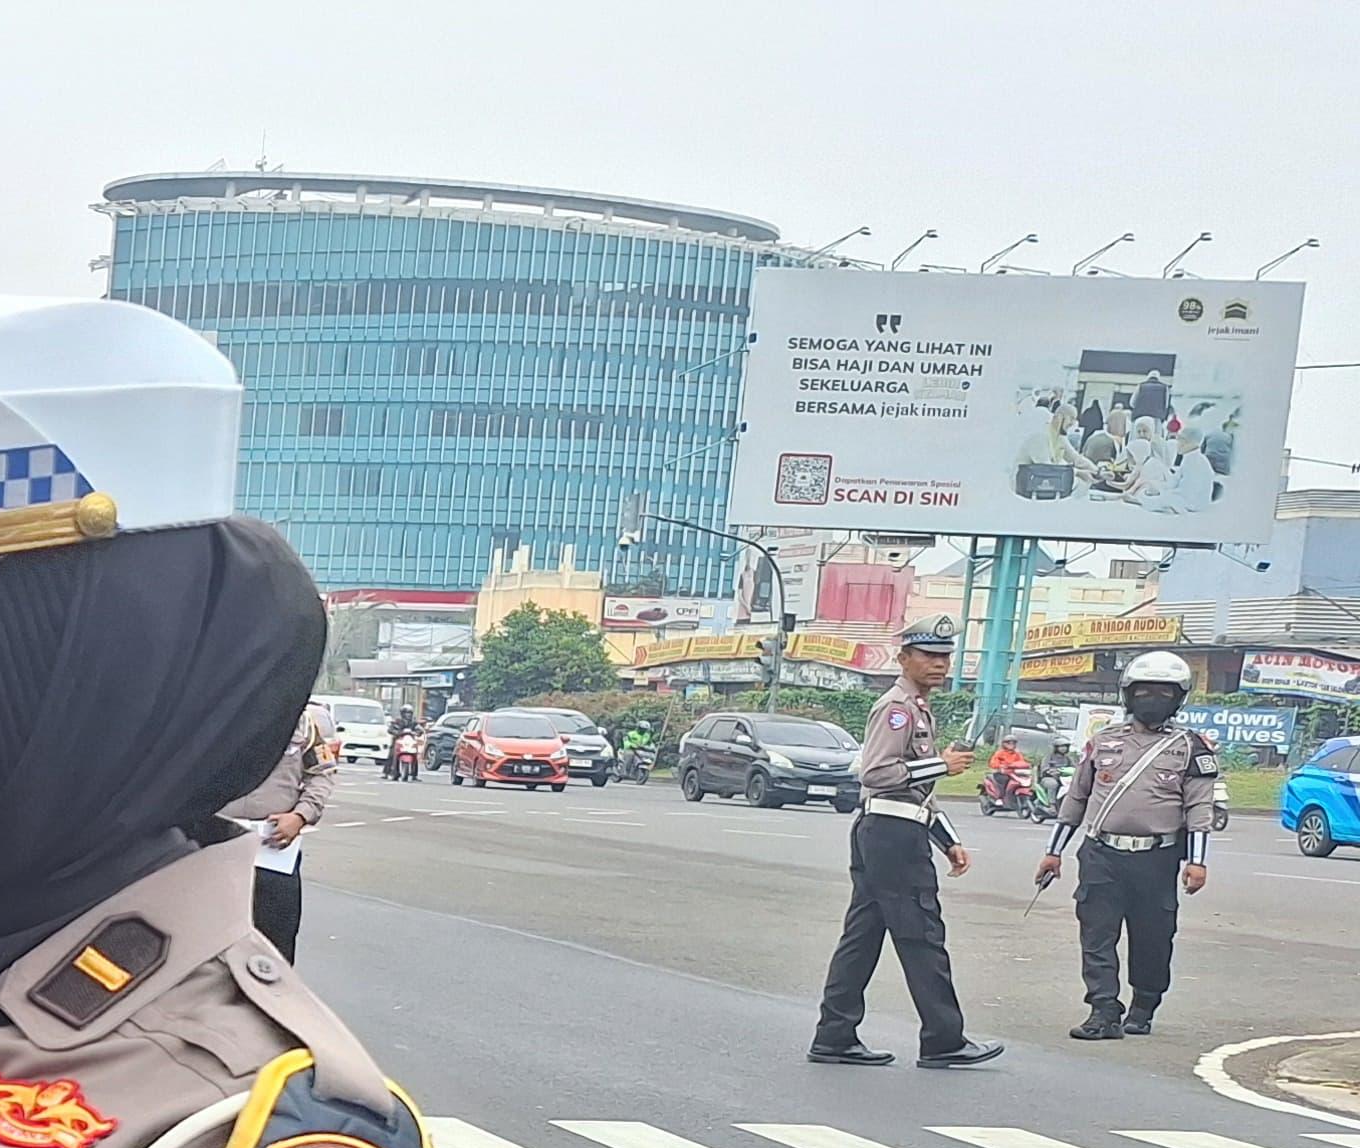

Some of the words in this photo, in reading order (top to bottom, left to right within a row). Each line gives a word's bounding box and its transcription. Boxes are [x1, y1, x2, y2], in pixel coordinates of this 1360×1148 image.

[787, 337, 860, 351] SEMOGA
[865, 339, 911, 353] YANG
[916, 341, 965, 356] LIHAT
[969, 343, 993, 356] INI
[791, 357, 831, 371] BISA
[836, 359, 873, 374] HAJI
[878, 360, 915, 374] DAN
[920, 362, 983, 376] UMRAH
[799, 378, 910, 394] SEKELUARGA
[795, 400, 878, 416] BERSAMA
[880, 402, 919, 418] jejak
[921, 404, 968, 418] imani
[834, 488, 887, 504] SCAN
[893, 490, 914, 505] DI
[920, 491, 959, 507] SINI
[1133, 616, 1167, 631] AUDIO
[1174, 711, 1208, 725] ow
[1213, 709, 1284, 728] down,
[1227, 726, 1286, 743] lives
